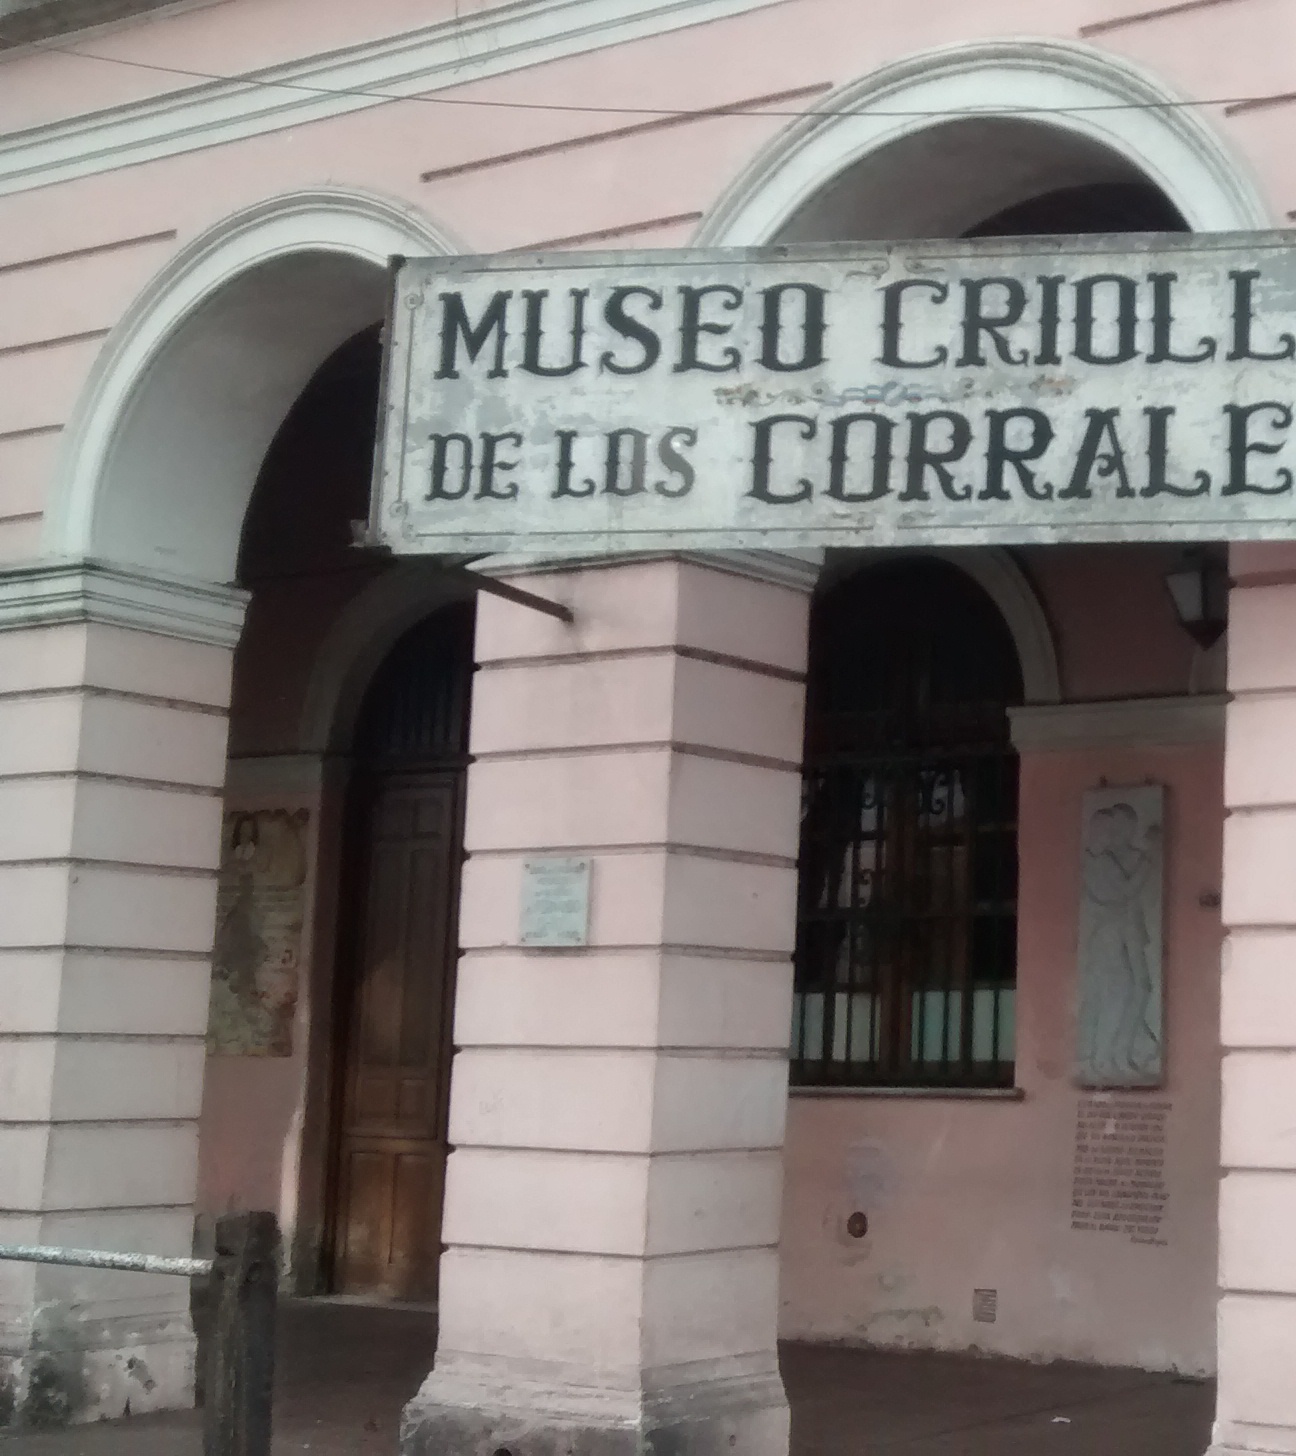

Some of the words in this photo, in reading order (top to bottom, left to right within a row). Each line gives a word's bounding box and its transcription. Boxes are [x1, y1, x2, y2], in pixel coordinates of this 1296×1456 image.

[433, 282, 832, 380] MUSEO
[424, 431, 524, 501] DE
[551, 425, 699, 500] LOS
